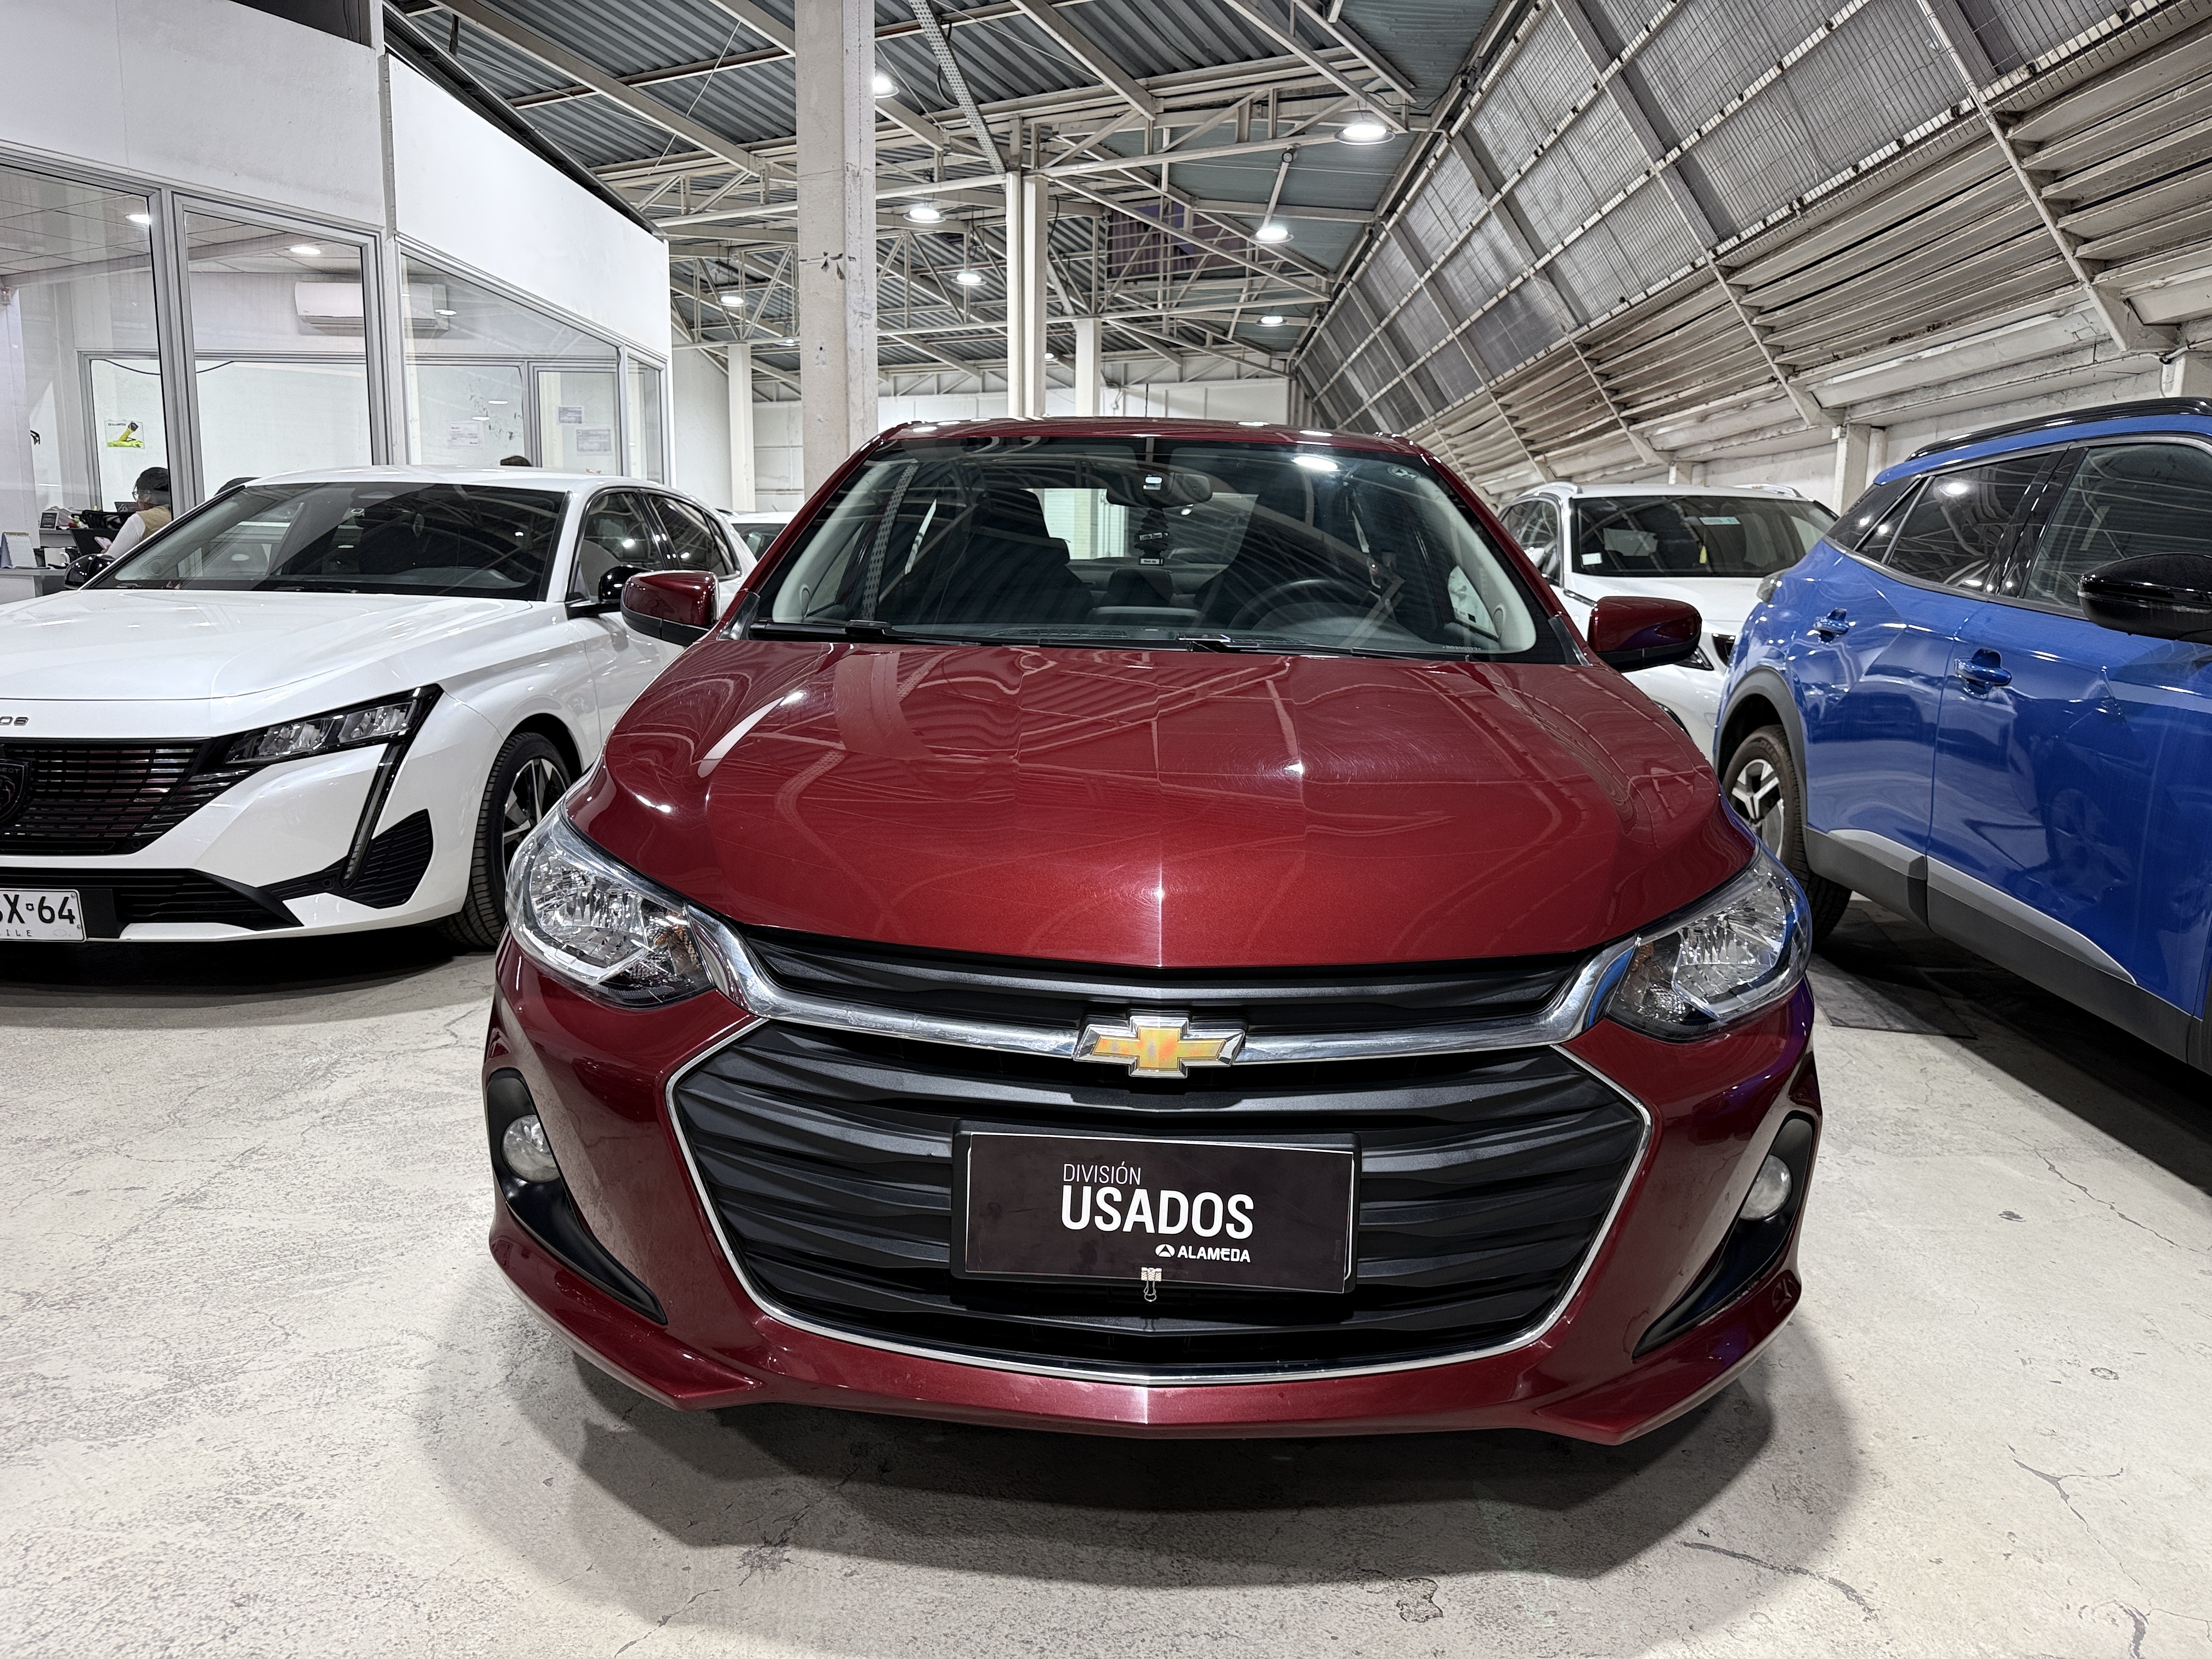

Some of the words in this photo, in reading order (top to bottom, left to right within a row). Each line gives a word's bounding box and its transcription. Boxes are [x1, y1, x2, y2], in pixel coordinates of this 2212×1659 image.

[1063, 1161, 1141, 1185] DIVISIÓN
[1062, 1185, 1254, 1239] USADOS
[1177, 1245, 1251, 1262] ALAMEDA
